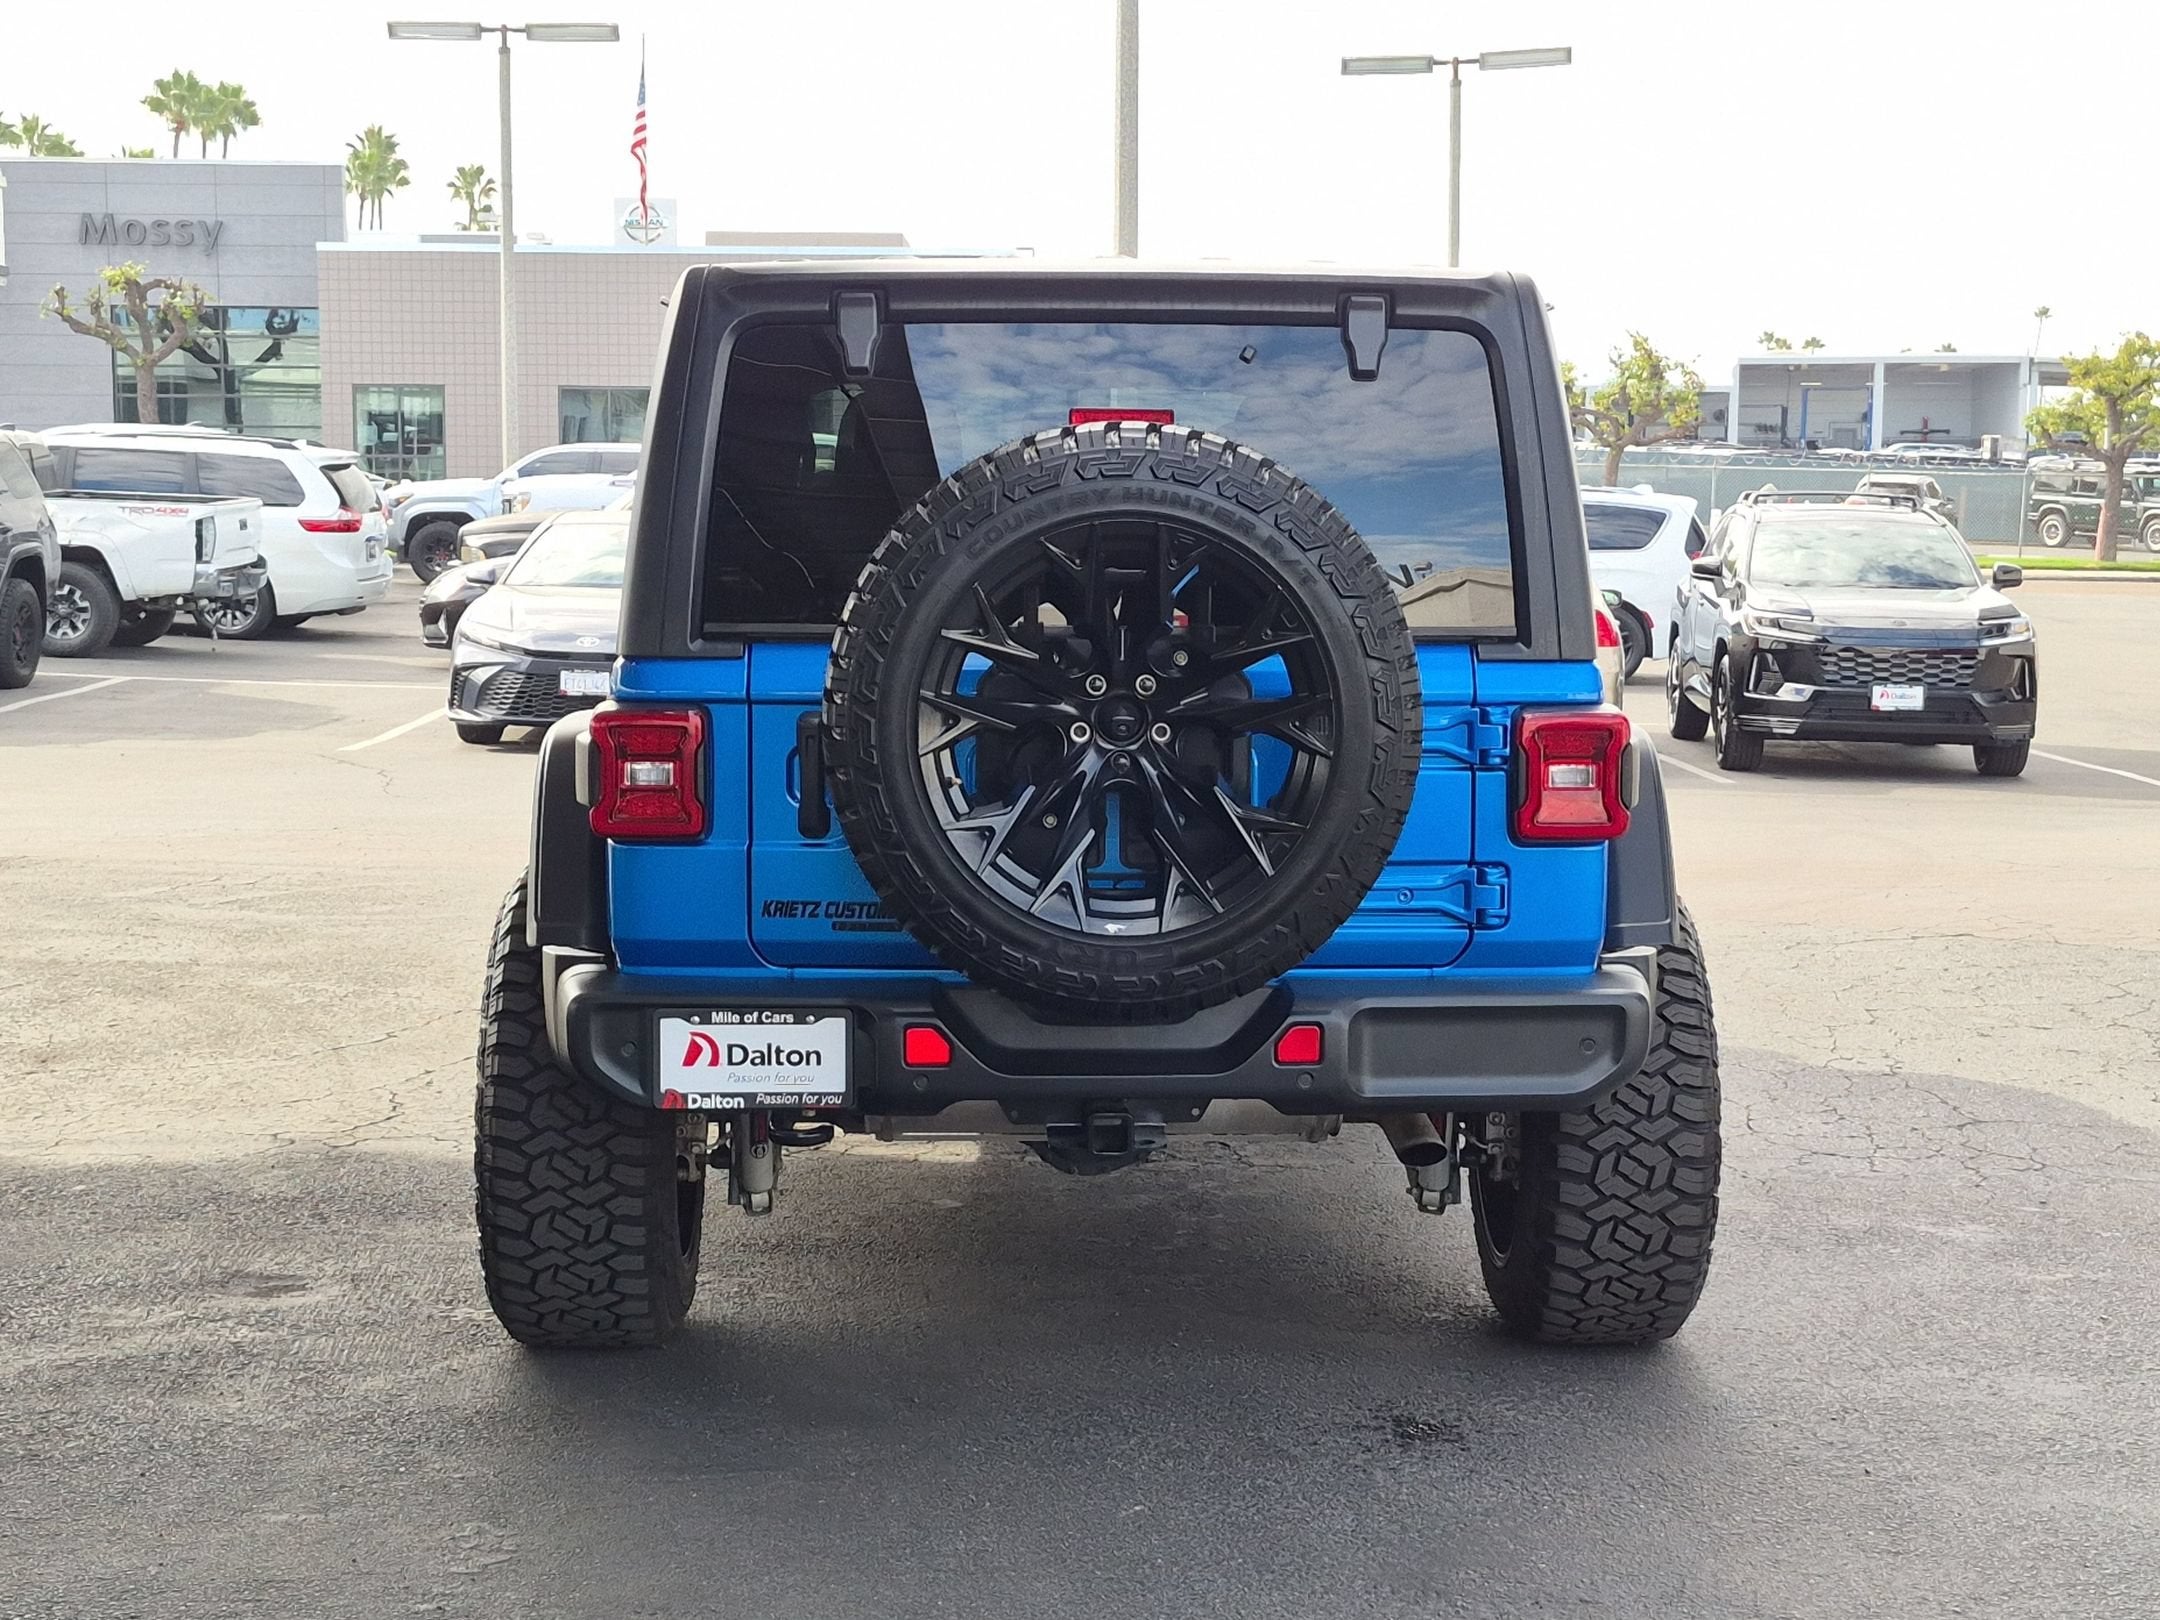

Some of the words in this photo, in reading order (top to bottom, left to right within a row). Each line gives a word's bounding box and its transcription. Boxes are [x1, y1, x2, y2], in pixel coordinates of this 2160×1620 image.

[624, 218, 664, 226] NISAN
[79, 212, 224, 256] Mossy
[965, 486, 1114, 560] COUNTRY
[1122, 486, 1257, 536] HUNTER
[761, 899, 822, 919] KRIETZ
[711, 1011, 740, 1024] Mile
[744, 1011, 759, 1024] of
[761, 1011, 794, 1024] Cars
[726, 1042, 822, 1067] Dalton
[727, 1071, 771, 1083] Passion
[774, 1071, 791, 1084] for
[792, 1073, 815, 1085] you
[687, 1093, 745, 1109] Dalton
[755, 1093, 799, 1105] Passion
[801, 1093, 818, 1105] for
[818, 1095, 843, 1106] you
